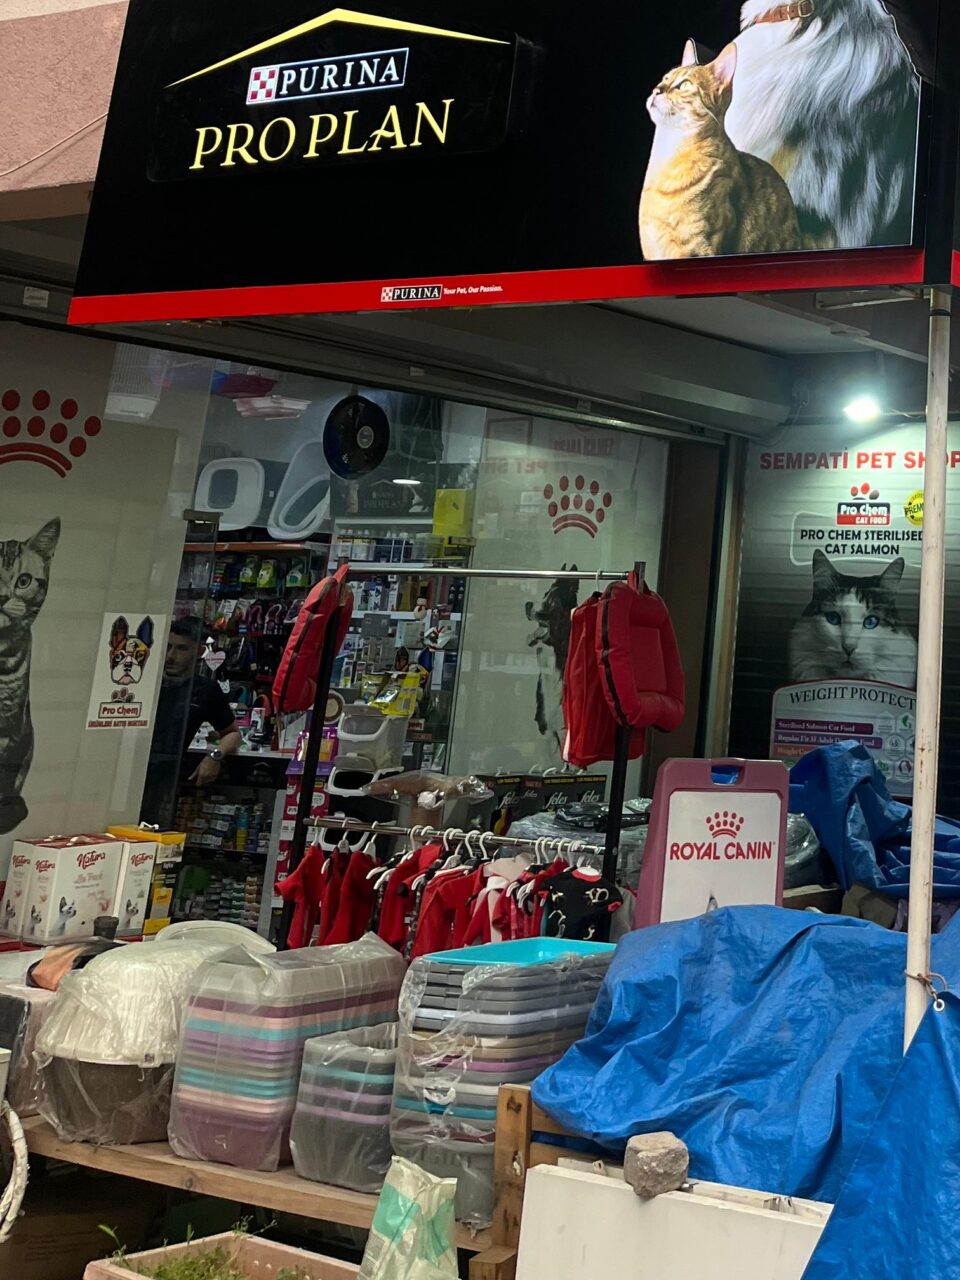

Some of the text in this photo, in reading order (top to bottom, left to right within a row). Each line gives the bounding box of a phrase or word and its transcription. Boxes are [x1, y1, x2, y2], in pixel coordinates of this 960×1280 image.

[280, 56, 399, 95] PURINA
[189, 98, 455, 170] PRO PLAN
[393, 287, 439, 300] PURINA
[759, 447, 849, 470] SEMPATİ
[856, 451, 896, 469] PET
[840, 503, 888, 517] Pro Chem
[869, 516, 887, 525] FOOD
[800, 530, 924, 541] PRO CHEM STERILISED
[825, 543, 900, 555] CAT SALMON
[789, 686, 848, 704] WEIGHT
[102, 705, 138, 716] Pro Chem
[542, 791, 568, 810] feles
[669, 841, 773, 860] ROYAL CANIN
